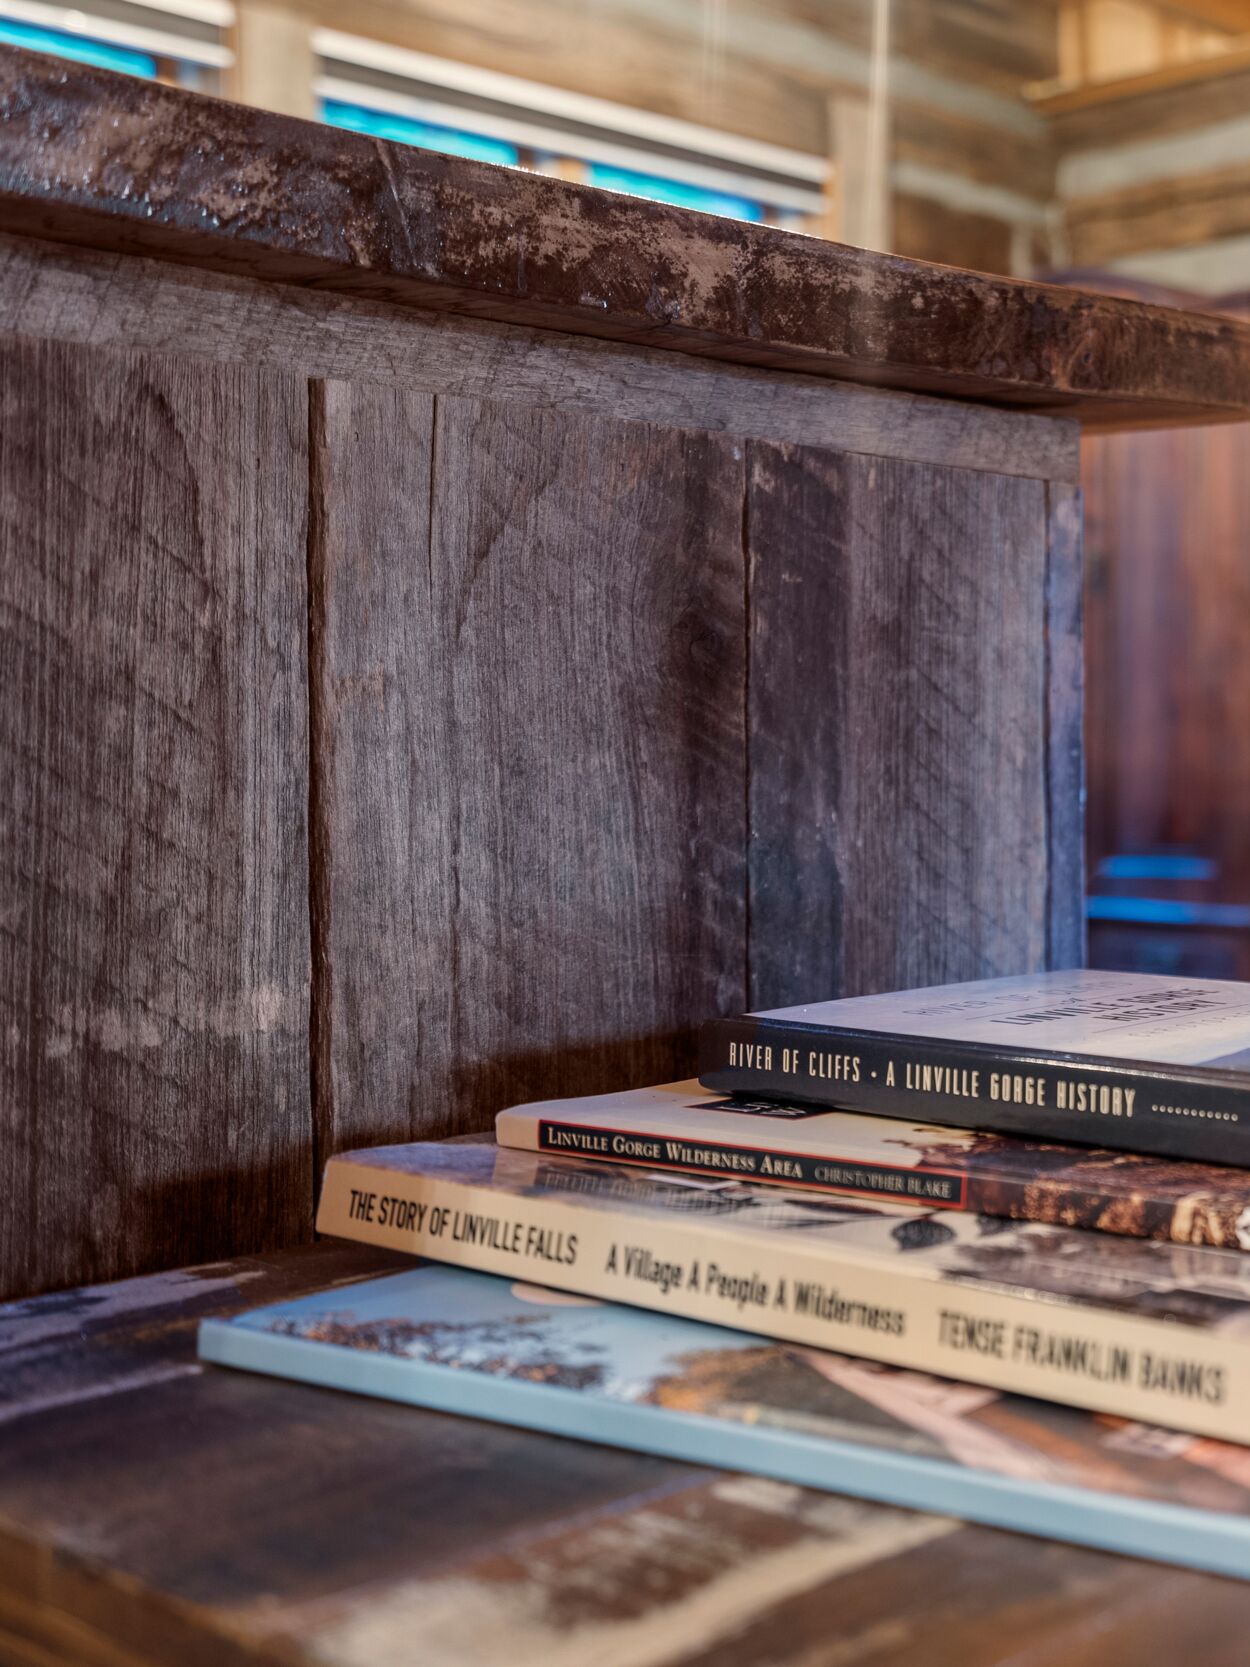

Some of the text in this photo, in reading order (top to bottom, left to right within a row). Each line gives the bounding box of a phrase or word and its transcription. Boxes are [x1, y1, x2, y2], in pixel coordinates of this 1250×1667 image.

[989, 987, 1220, 1026] LINVILLE GORGE
[1093, 998, 1228, 1022] HISTORY
[729, 1042, 772, 1071] RIVER
[782, 1048, 799, 1074] OF
[808, 1051, 860, 1082] CLIFFS
[886, 1060, 895, 1087] A
[906, 1062, 980, 1098] LINVILLE
[990, 1072, 1046, 1107] GORGE
[1056, 1080, 1136, 1118] HISTORY
[547, 1126, 951, 1199] LINVILLE GORGE WILDERNESS AREA CHRISTOPHER BLAKE
[349, 1189, 1228, 1404] THE STORY OF LINVILLE FALLS A Village A People A Wilderness TENSE FRANKLIN BANKS
